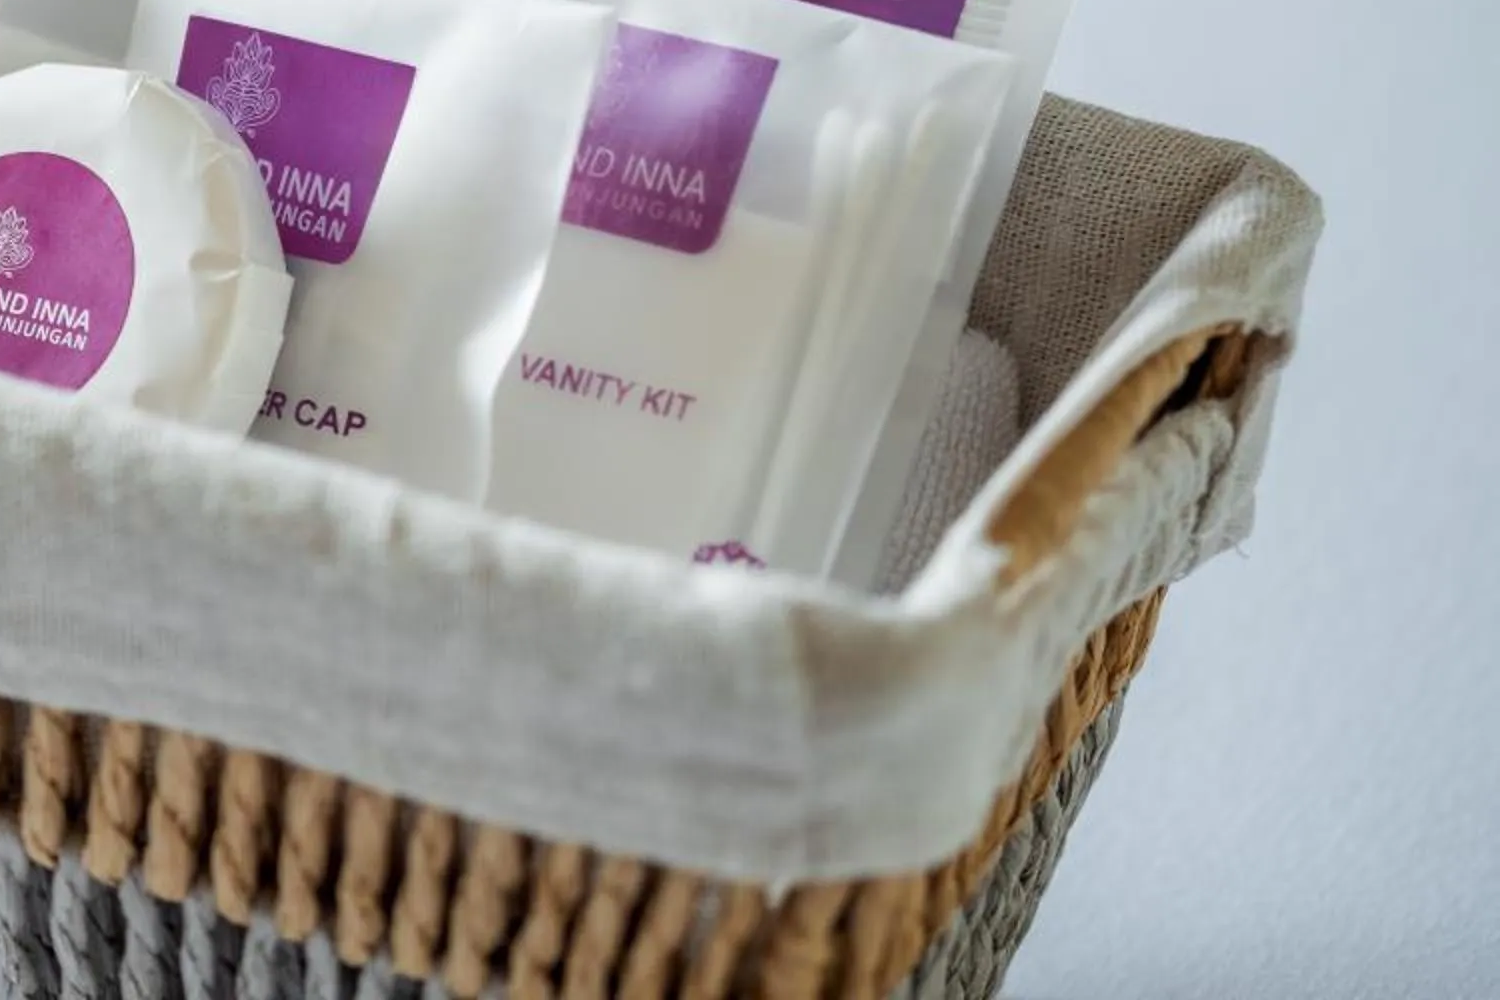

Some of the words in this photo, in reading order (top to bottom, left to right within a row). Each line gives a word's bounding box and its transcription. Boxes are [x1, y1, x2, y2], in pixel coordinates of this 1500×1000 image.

[277, 165, 352, 217] INNA
[620, 152, 707, 205] INNA
[31, 297, 91, 333] INNA
[520, 352, 637, 406] VANITY
[639, 385, 698, 422] KIT
[294, 399, 368, 437] CAP
